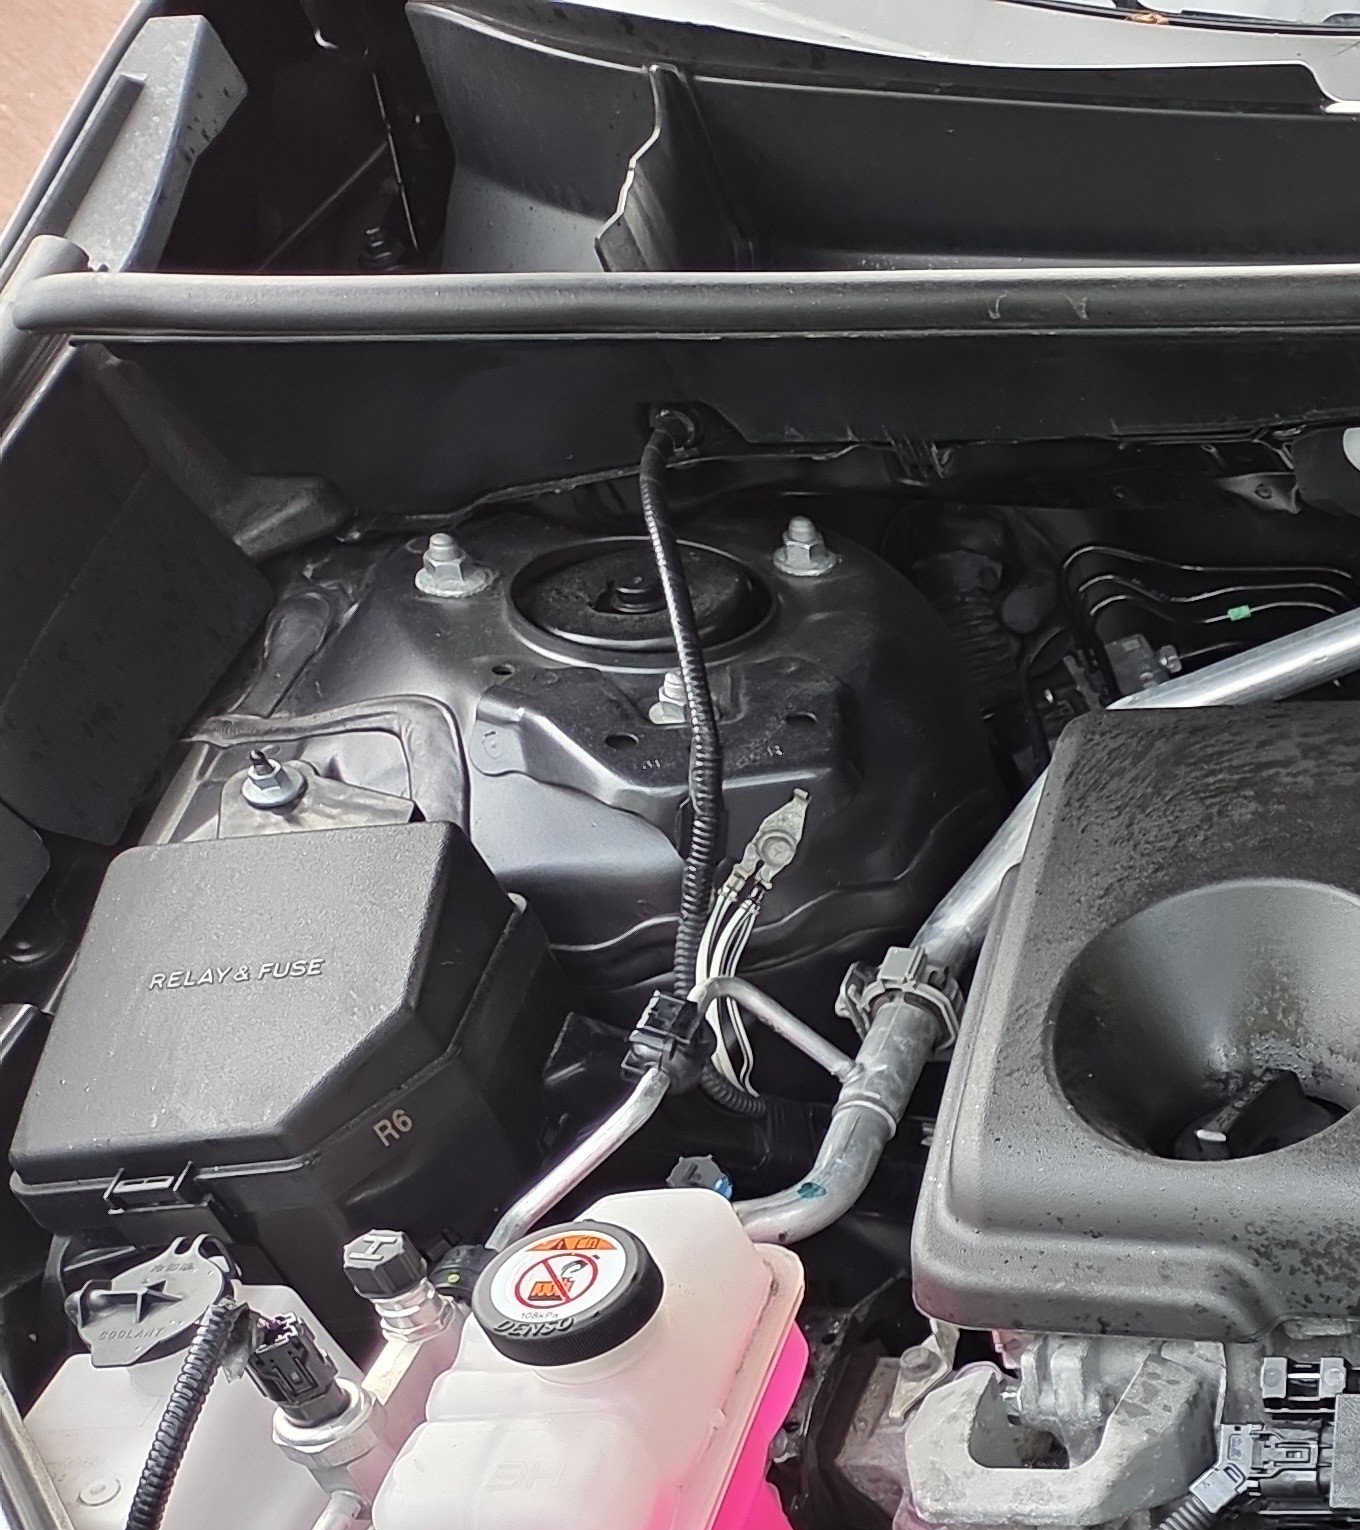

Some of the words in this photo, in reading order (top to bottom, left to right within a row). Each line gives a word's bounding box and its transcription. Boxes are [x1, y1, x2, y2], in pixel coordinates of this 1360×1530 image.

[149, 967, 233, 990] RELAY
[233, 966, 251, 981] &
[258, 958, 325, 979] FUSE
[373, 1109, 412, 1147] R6
[100, 1327, 164, 1341] COOLANT
[494, 1318, 574, 1337] DENSO
